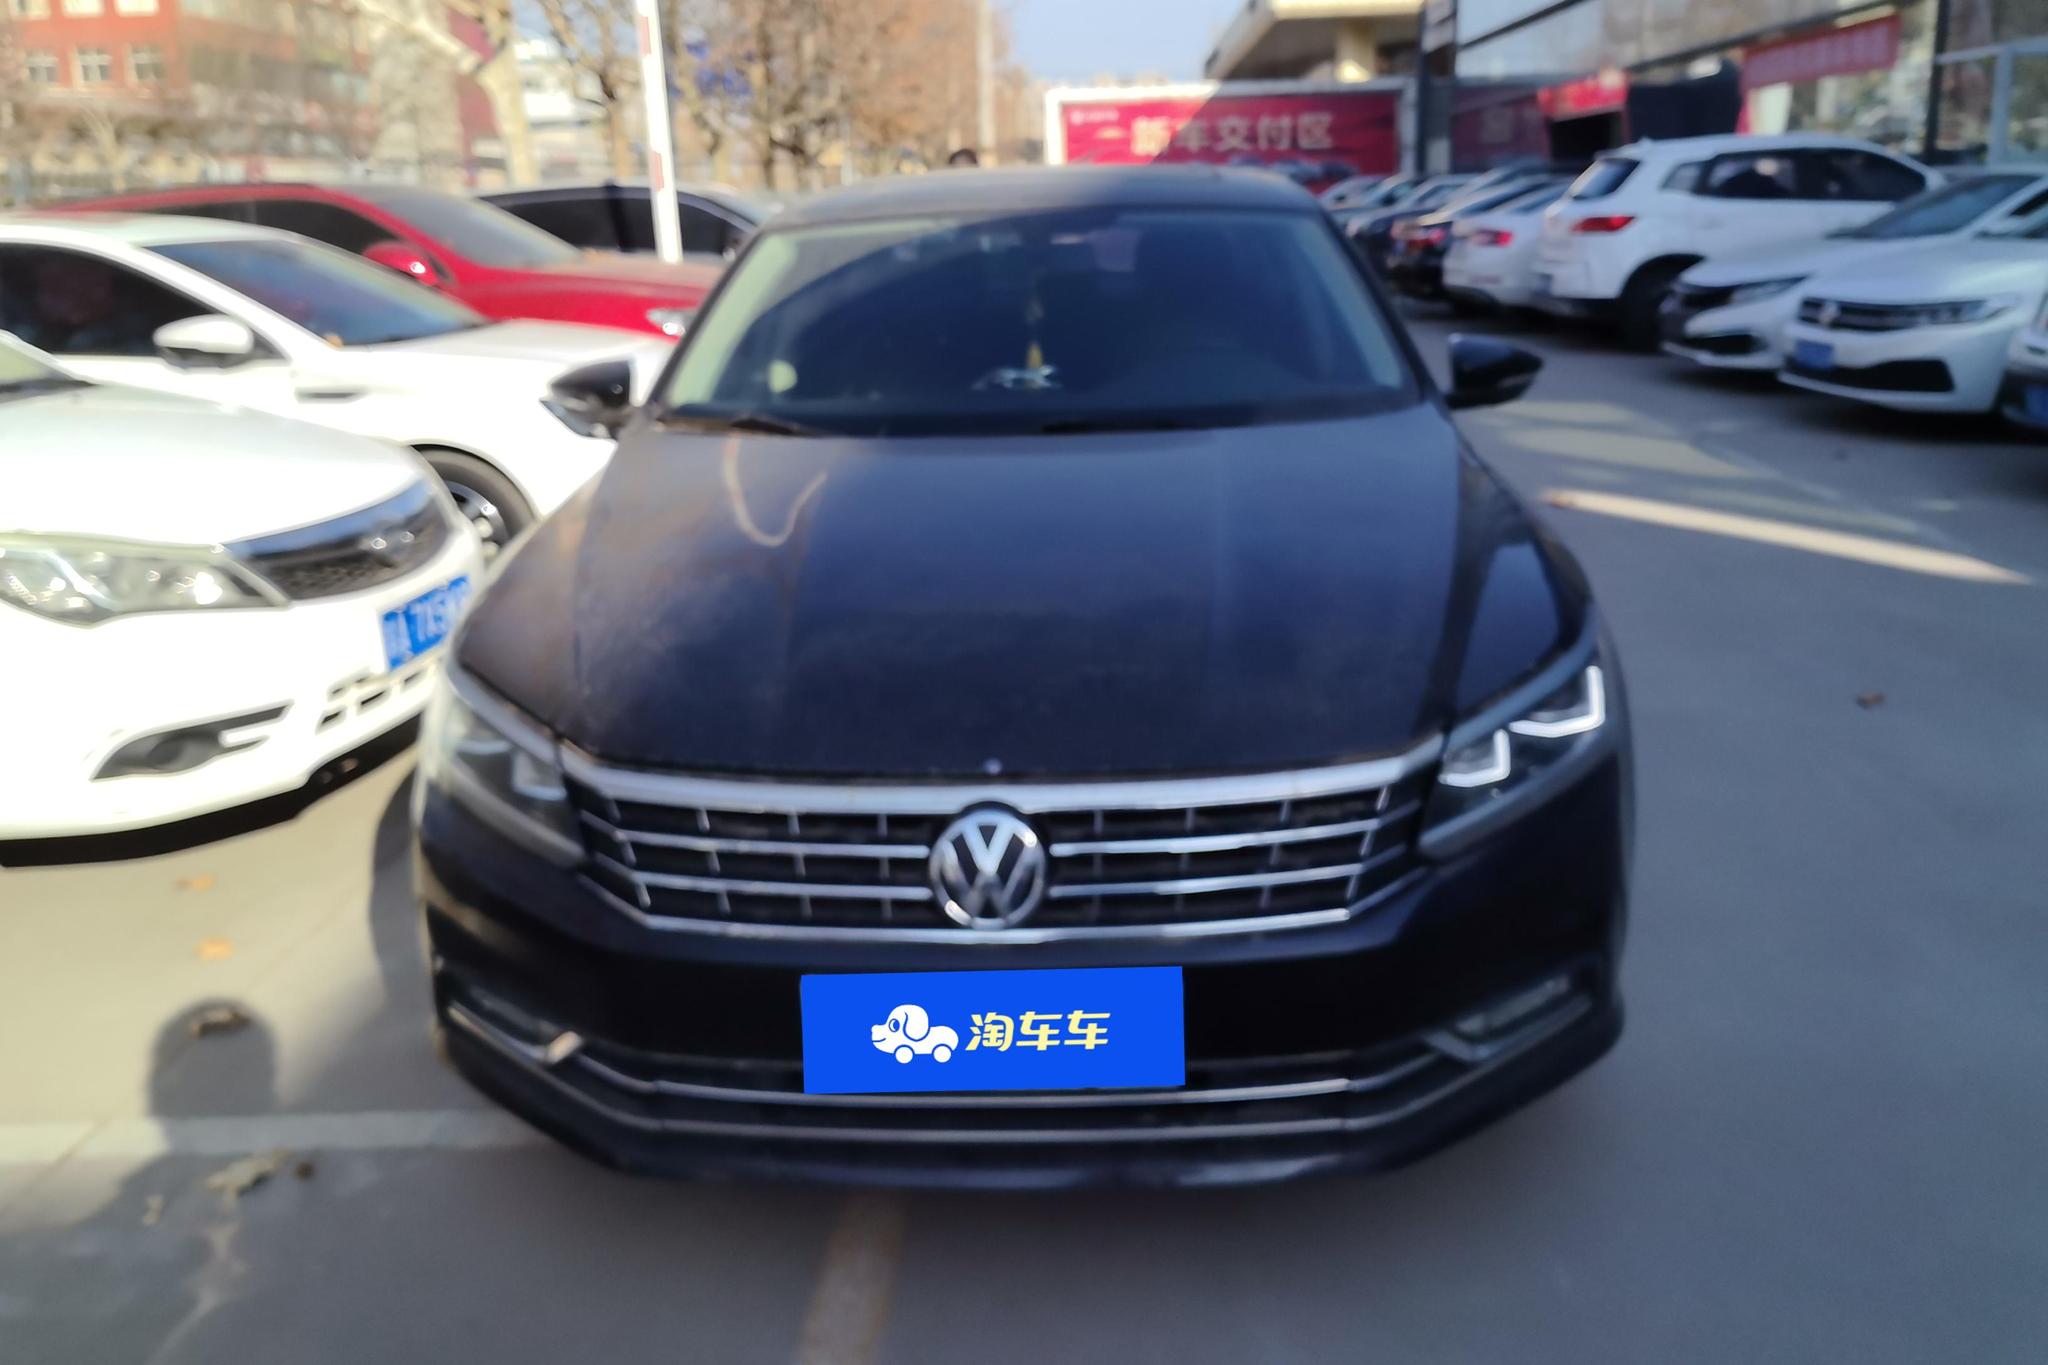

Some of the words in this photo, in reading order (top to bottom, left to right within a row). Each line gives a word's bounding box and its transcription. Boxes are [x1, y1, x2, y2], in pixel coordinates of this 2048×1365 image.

[1131, 112, 1334, 157] 新车交付区
